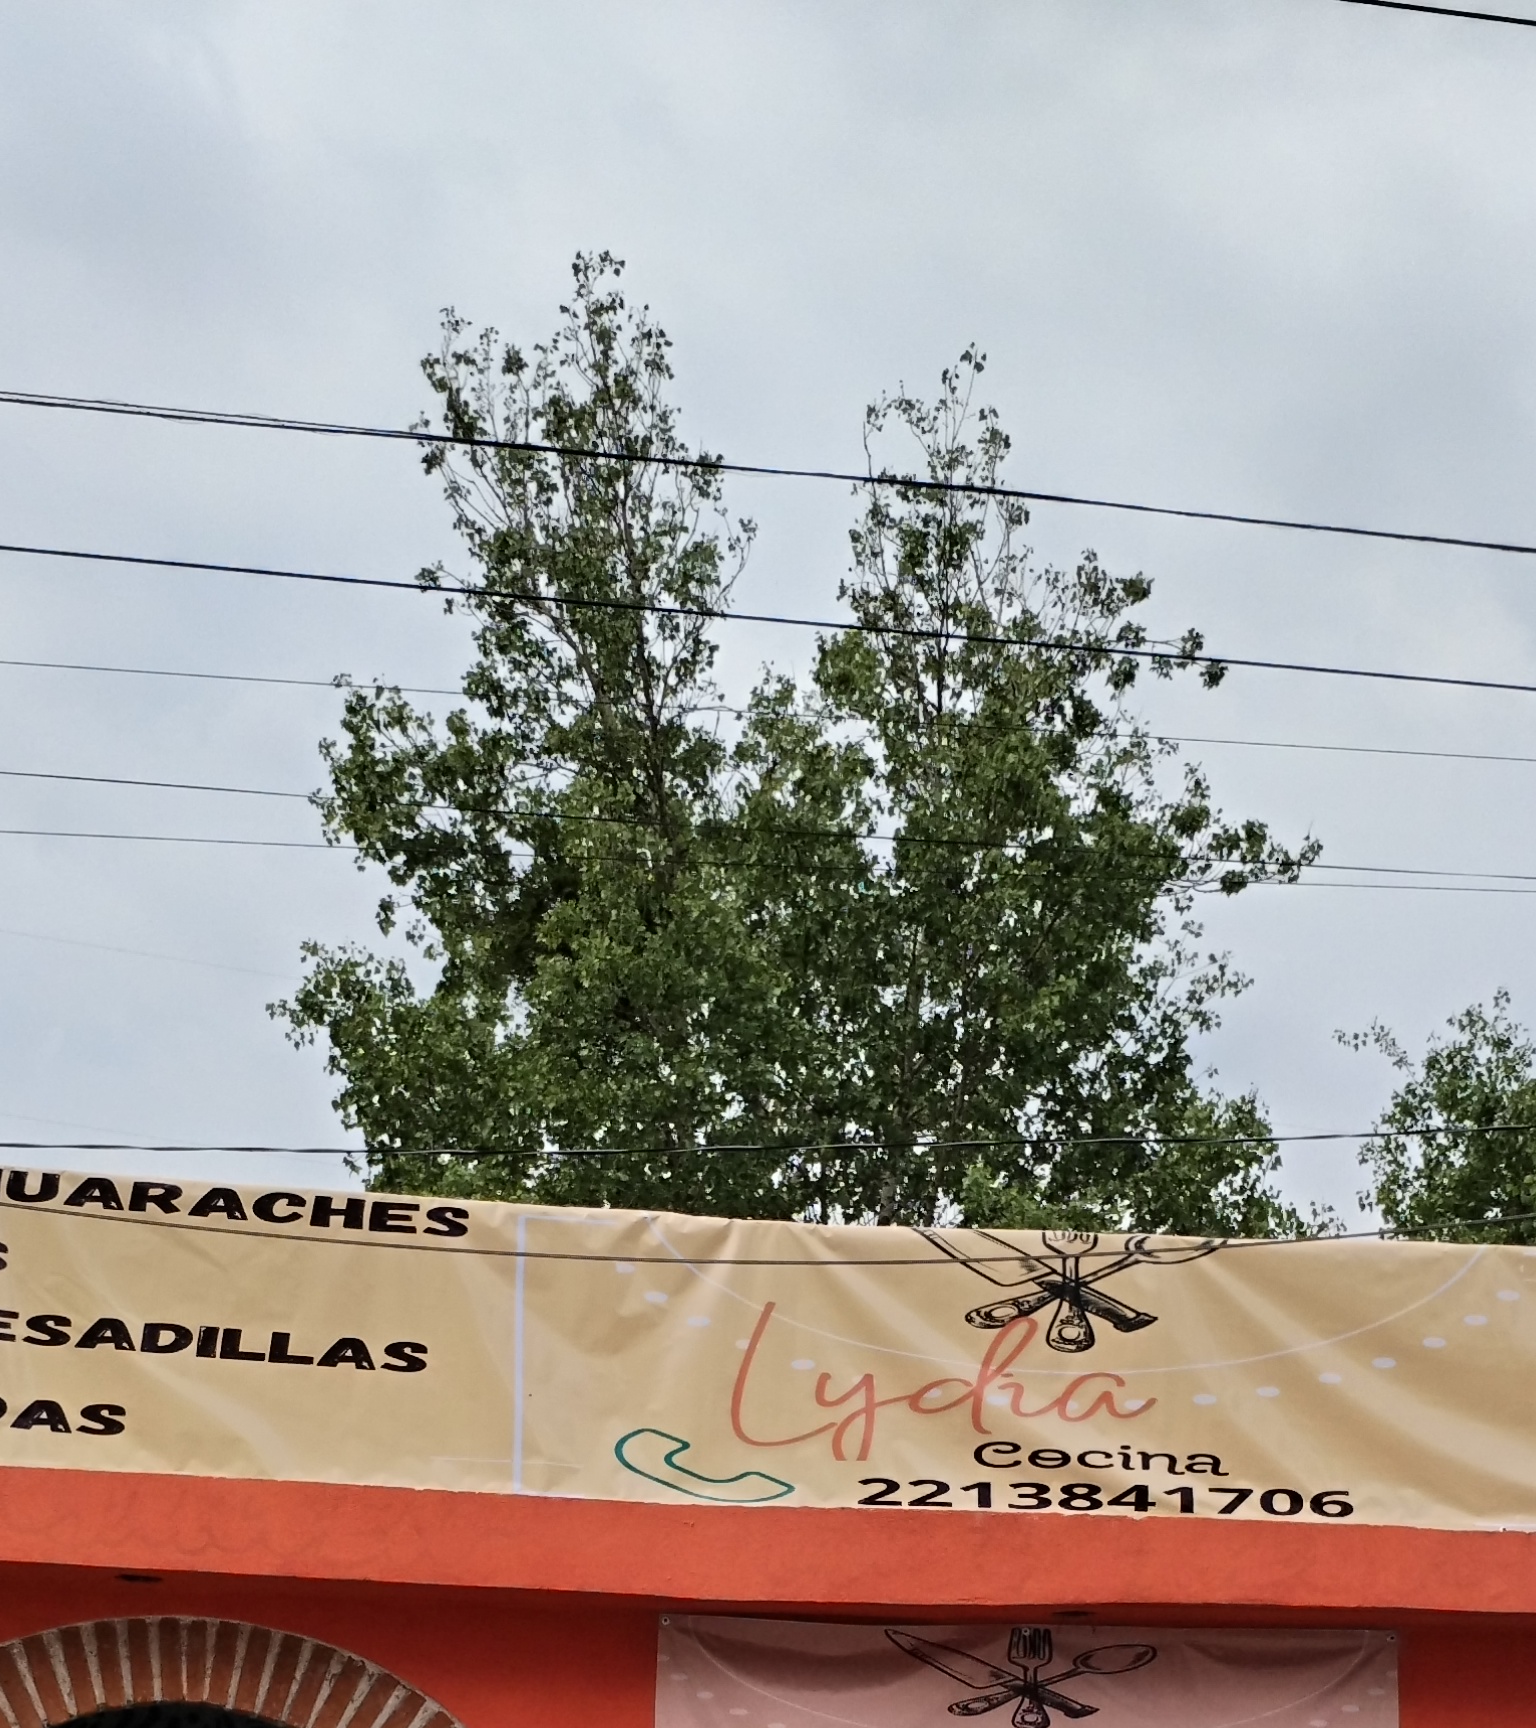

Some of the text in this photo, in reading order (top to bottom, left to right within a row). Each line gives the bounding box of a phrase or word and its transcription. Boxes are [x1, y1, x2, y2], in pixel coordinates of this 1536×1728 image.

[730, 1300, 1158, 1462] Lydia
[972, 1440, 1231, 1478] Cocina
[856, 1476, 1356, 1519] 2213841706
